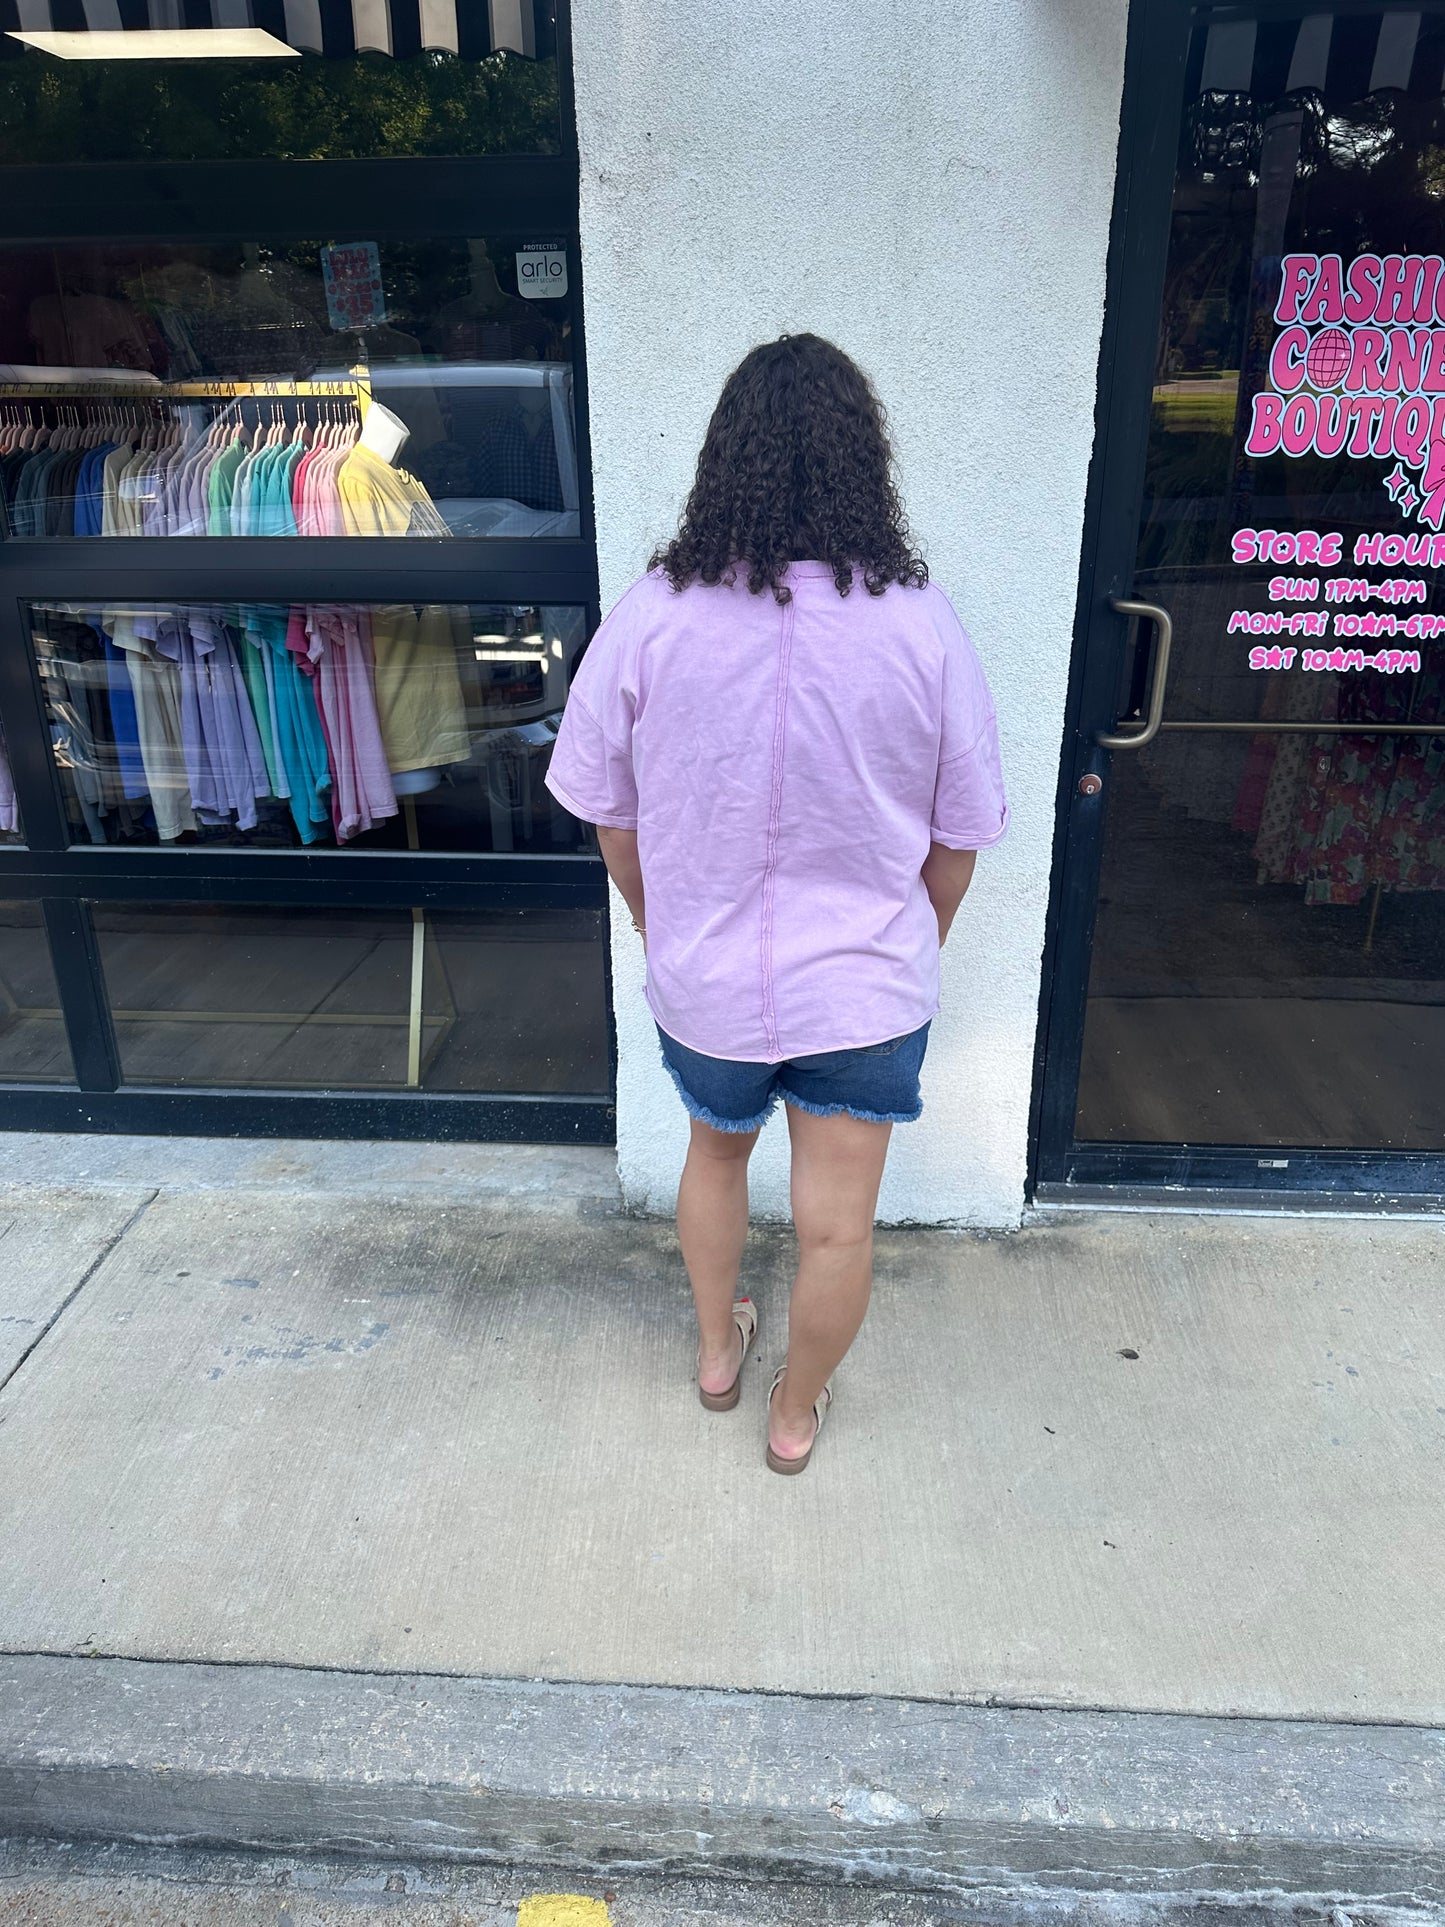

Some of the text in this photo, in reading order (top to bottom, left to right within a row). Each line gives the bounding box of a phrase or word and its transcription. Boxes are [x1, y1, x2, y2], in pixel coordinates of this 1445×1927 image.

[522, 243, 558, 251] PROTECTED
[521, 255, 563, 277] arlo
[1273, 254, 1445, 326] FASHI
[1231, 528, 1343, 567] STORE
[1268, 576, 1427, 604] SUN 1PM-4PM
